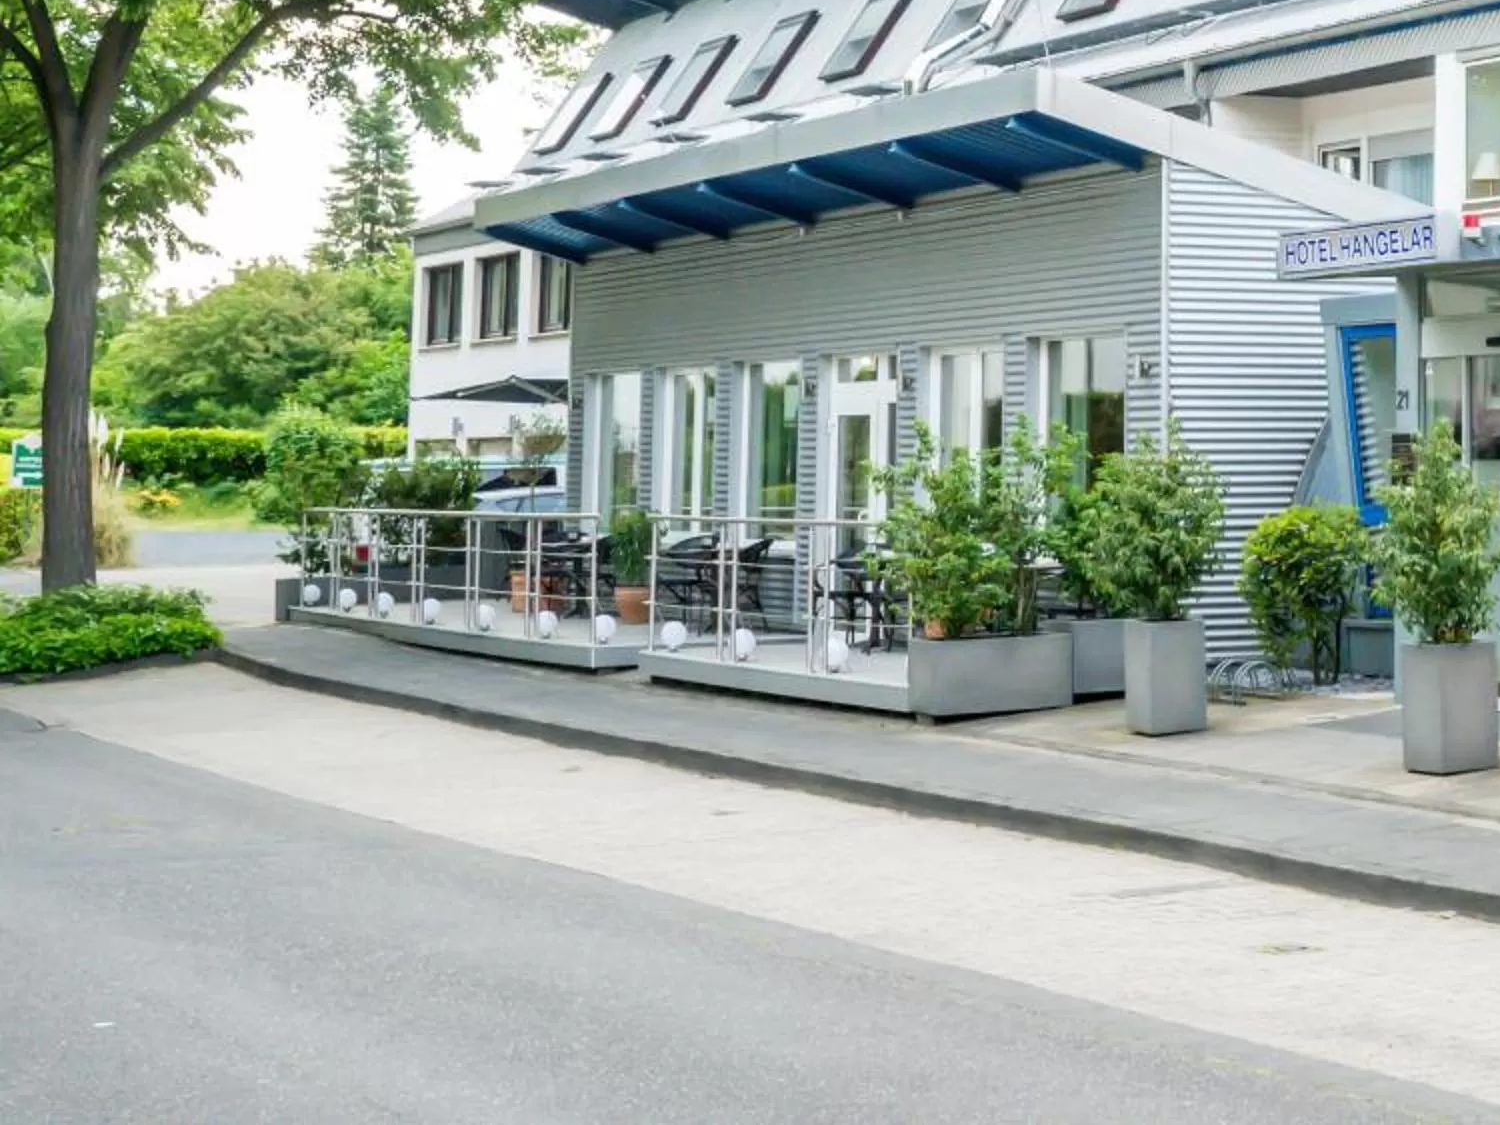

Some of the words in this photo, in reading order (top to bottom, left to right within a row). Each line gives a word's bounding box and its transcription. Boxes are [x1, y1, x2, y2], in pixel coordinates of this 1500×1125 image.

[1285, 238, 1337, 265] HOTEL
[1340, 226, 1434, 258] HANGELAR
[1396, 390, 1409, 410] 21
